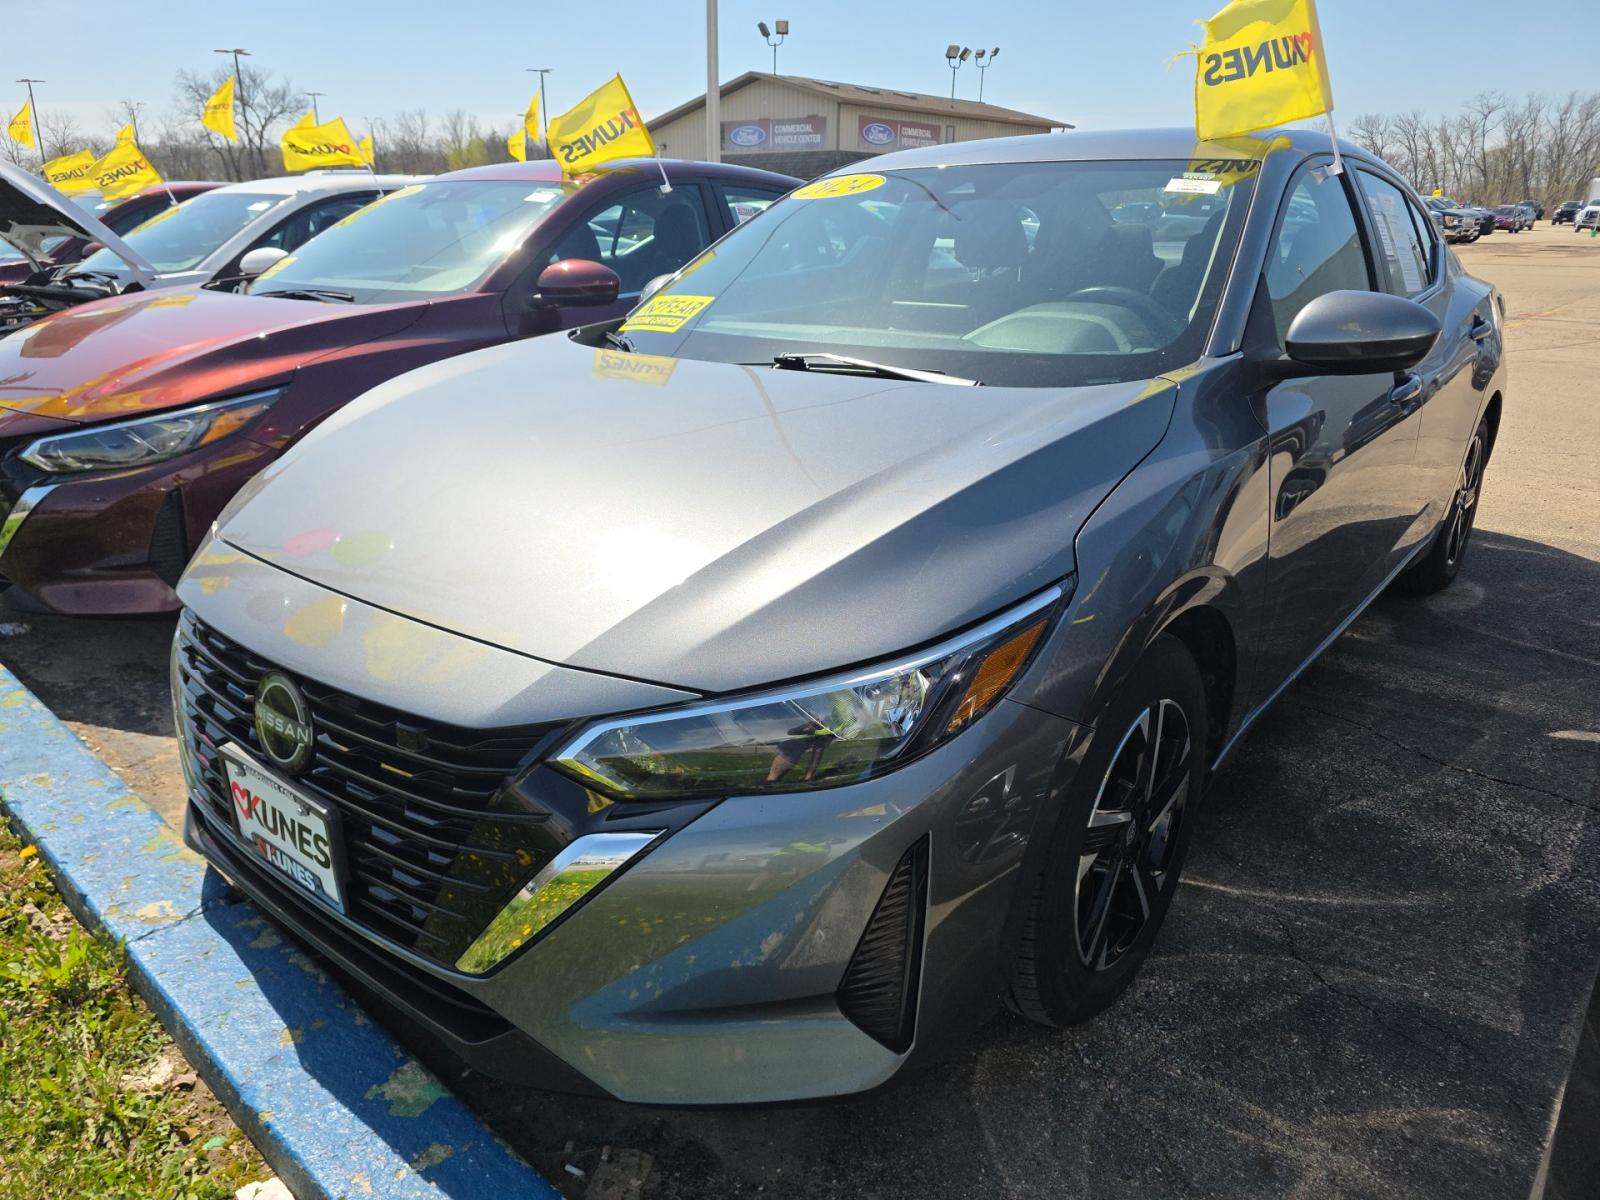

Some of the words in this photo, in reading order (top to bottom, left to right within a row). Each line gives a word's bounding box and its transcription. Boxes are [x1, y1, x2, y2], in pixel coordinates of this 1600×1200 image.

[774, 123, 814, 133] COMMERCIAL
[774, 134, 798, 145] VEHICLE
[798, 134, 821, 144] CENTER
[901, 126, 933, 138] COMMERCIAL
[257, 706, 309, 742] NISSAN
[245, 786, 332, 870] KUNES
[265, 842, 317, 892] KUNES
